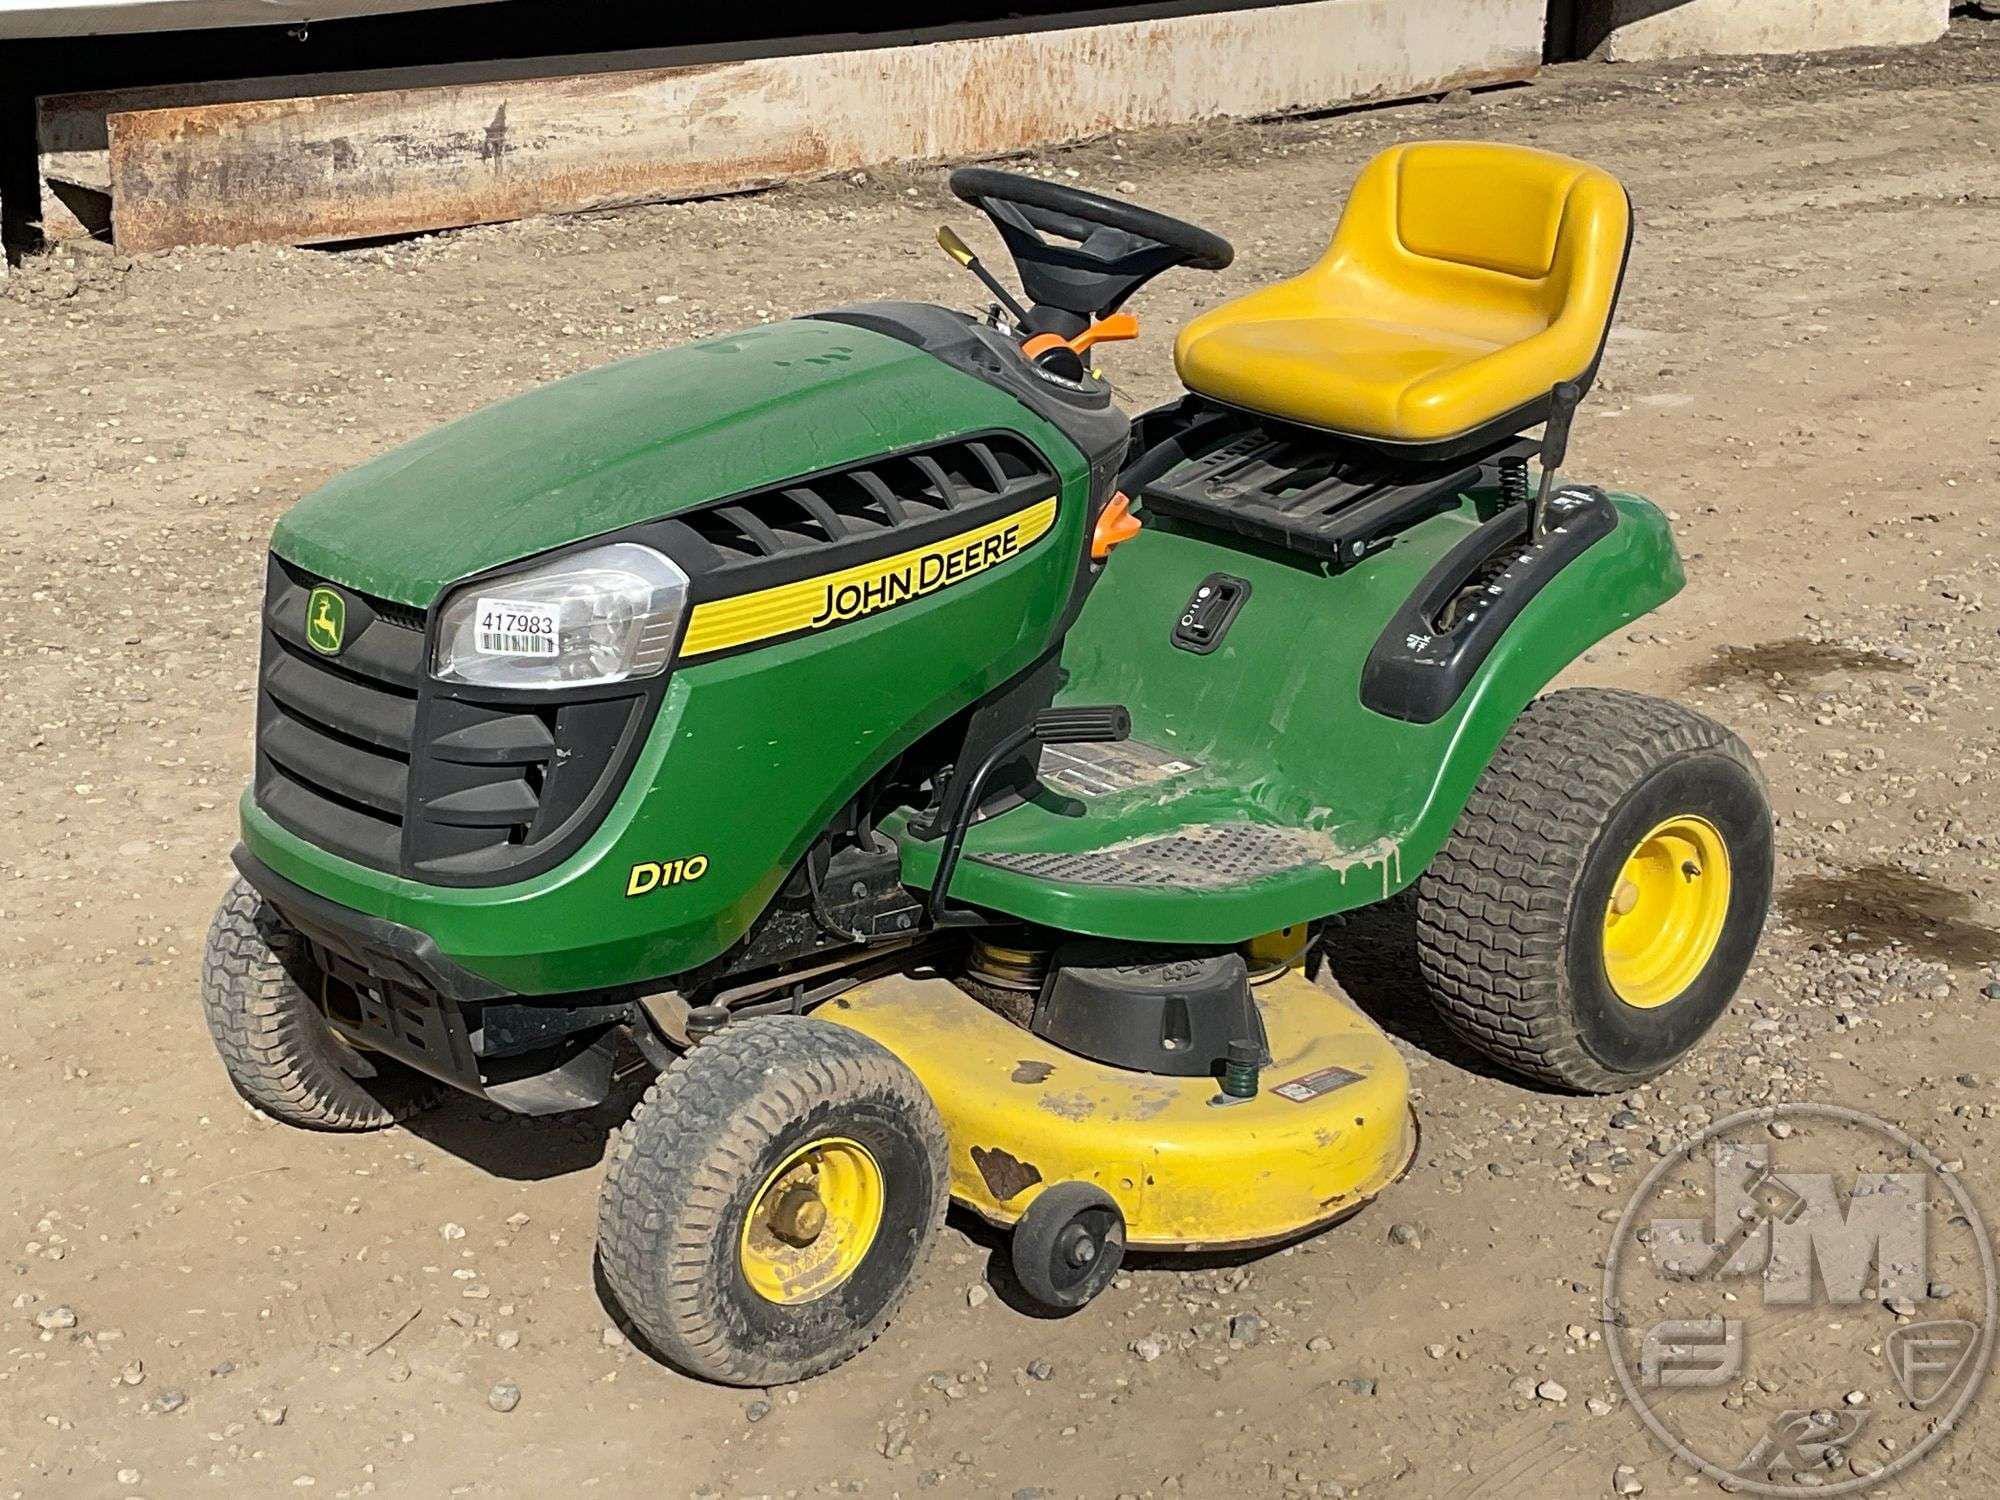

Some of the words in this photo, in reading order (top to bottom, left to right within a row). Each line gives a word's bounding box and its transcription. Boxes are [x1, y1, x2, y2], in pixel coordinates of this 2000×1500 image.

[812, 567, 912, 624] JOHN
[918, 524, 1020, 588] DEERE
[482, 612, 553, 634] 417983
[625, 854, 709, 897] D110
